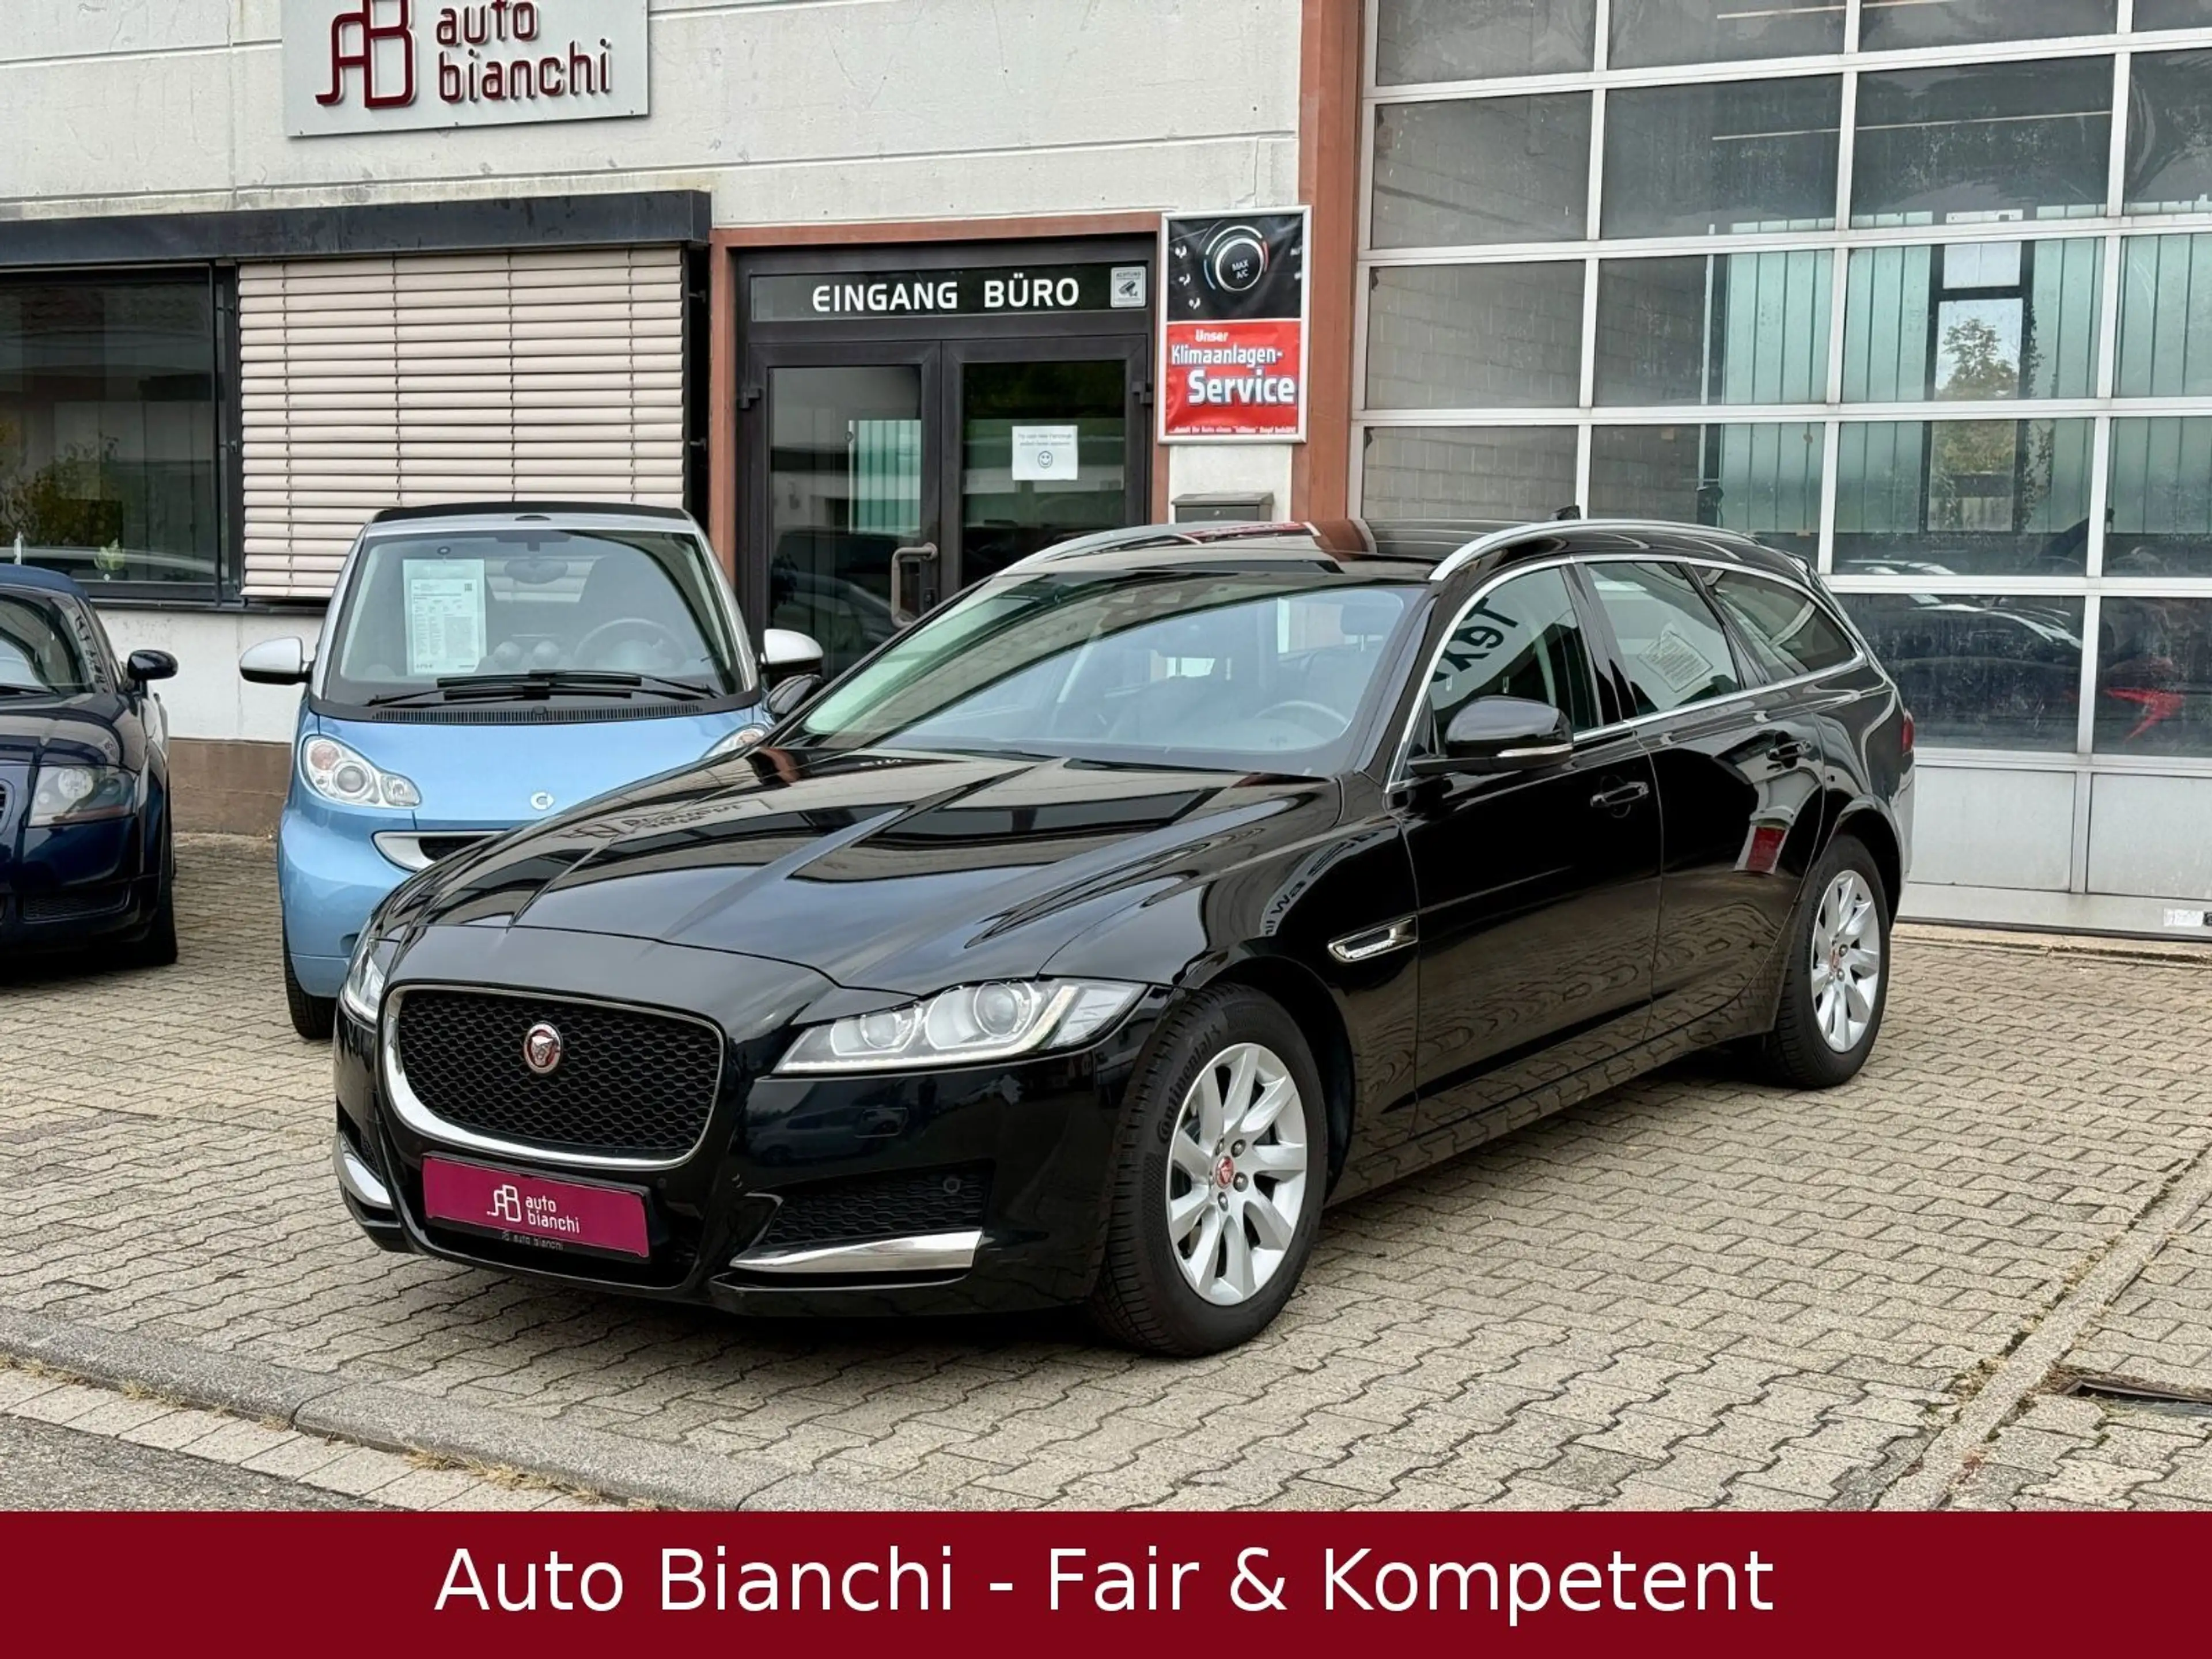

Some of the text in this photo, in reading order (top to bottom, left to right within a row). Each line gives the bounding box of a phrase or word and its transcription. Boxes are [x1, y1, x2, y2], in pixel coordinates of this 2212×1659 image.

[436, 0, 539, 46] auto
[438, 37, 613, 104] bianchi
[1232, 259, 1249, 271] MAX
[813, 272, 1080, 312] EINGANG BÜRO
[1195, 329, 1229, 342] Unser
[1172, 344, 1283, 367] Klimaanlagen-
[1188, 369, 1296, 404] Service
[525, 1195, 556, 1213] auto
[528, 1209, 580, 1233] bianchi
[514, 1234, 531, 1245] auto
[533, 1238, 563, 1251] bianchi
